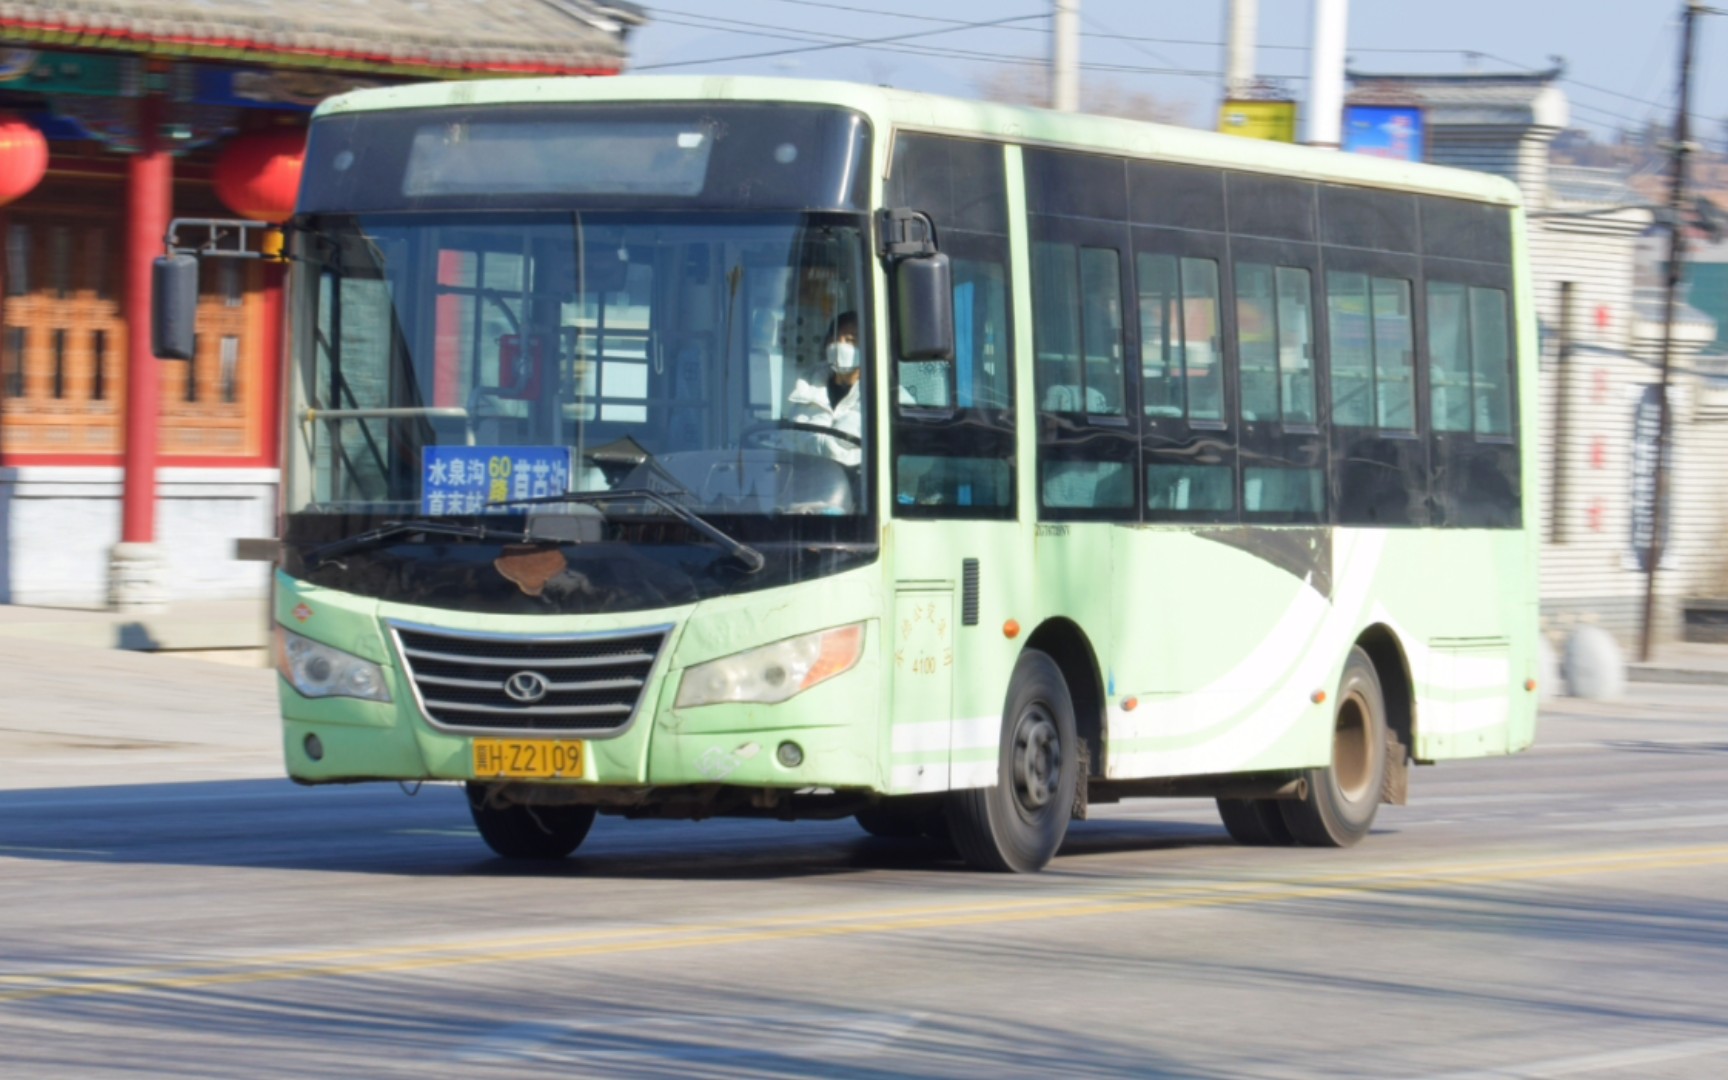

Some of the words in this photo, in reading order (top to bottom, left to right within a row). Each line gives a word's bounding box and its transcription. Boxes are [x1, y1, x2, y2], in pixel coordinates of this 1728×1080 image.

[428, 458, 485, 486] 水泉沟
[488, 456, 511, 478] 60
